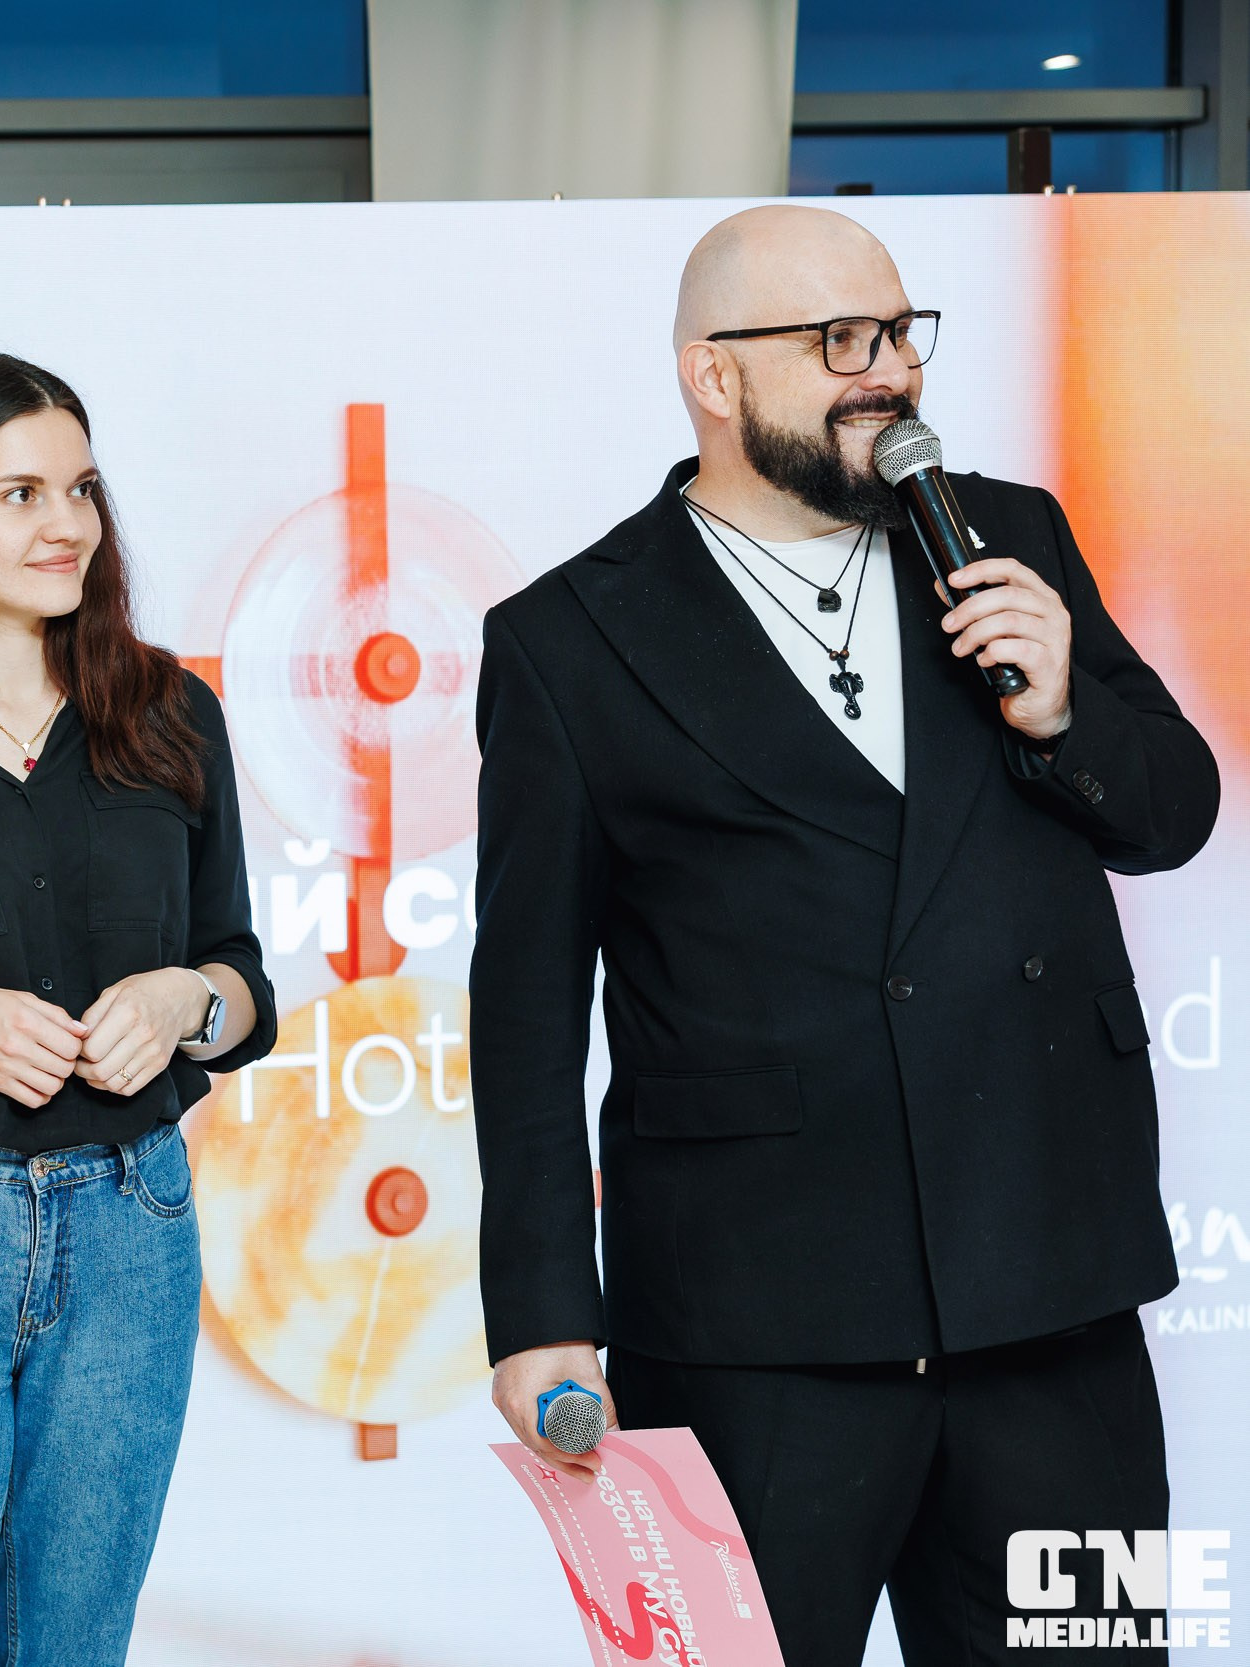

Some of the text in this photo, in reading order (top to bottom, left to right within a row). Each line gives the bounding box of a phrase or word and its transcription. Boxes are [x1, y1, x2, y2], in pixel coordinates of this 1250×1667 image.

[251, 838, 478, 954] й с
[520, 1464, 552, 1505] бесплатный
[549, 1505, 580, 1567] двухнедельный
[575, 1567, 593, 1600] доступ
[626, 1489, 675, 1570] начни
[629, 1545, 648, 1562] в
[637, 1571, 669, 1619] My
[710, 1541, 743, 1602] Radisson
